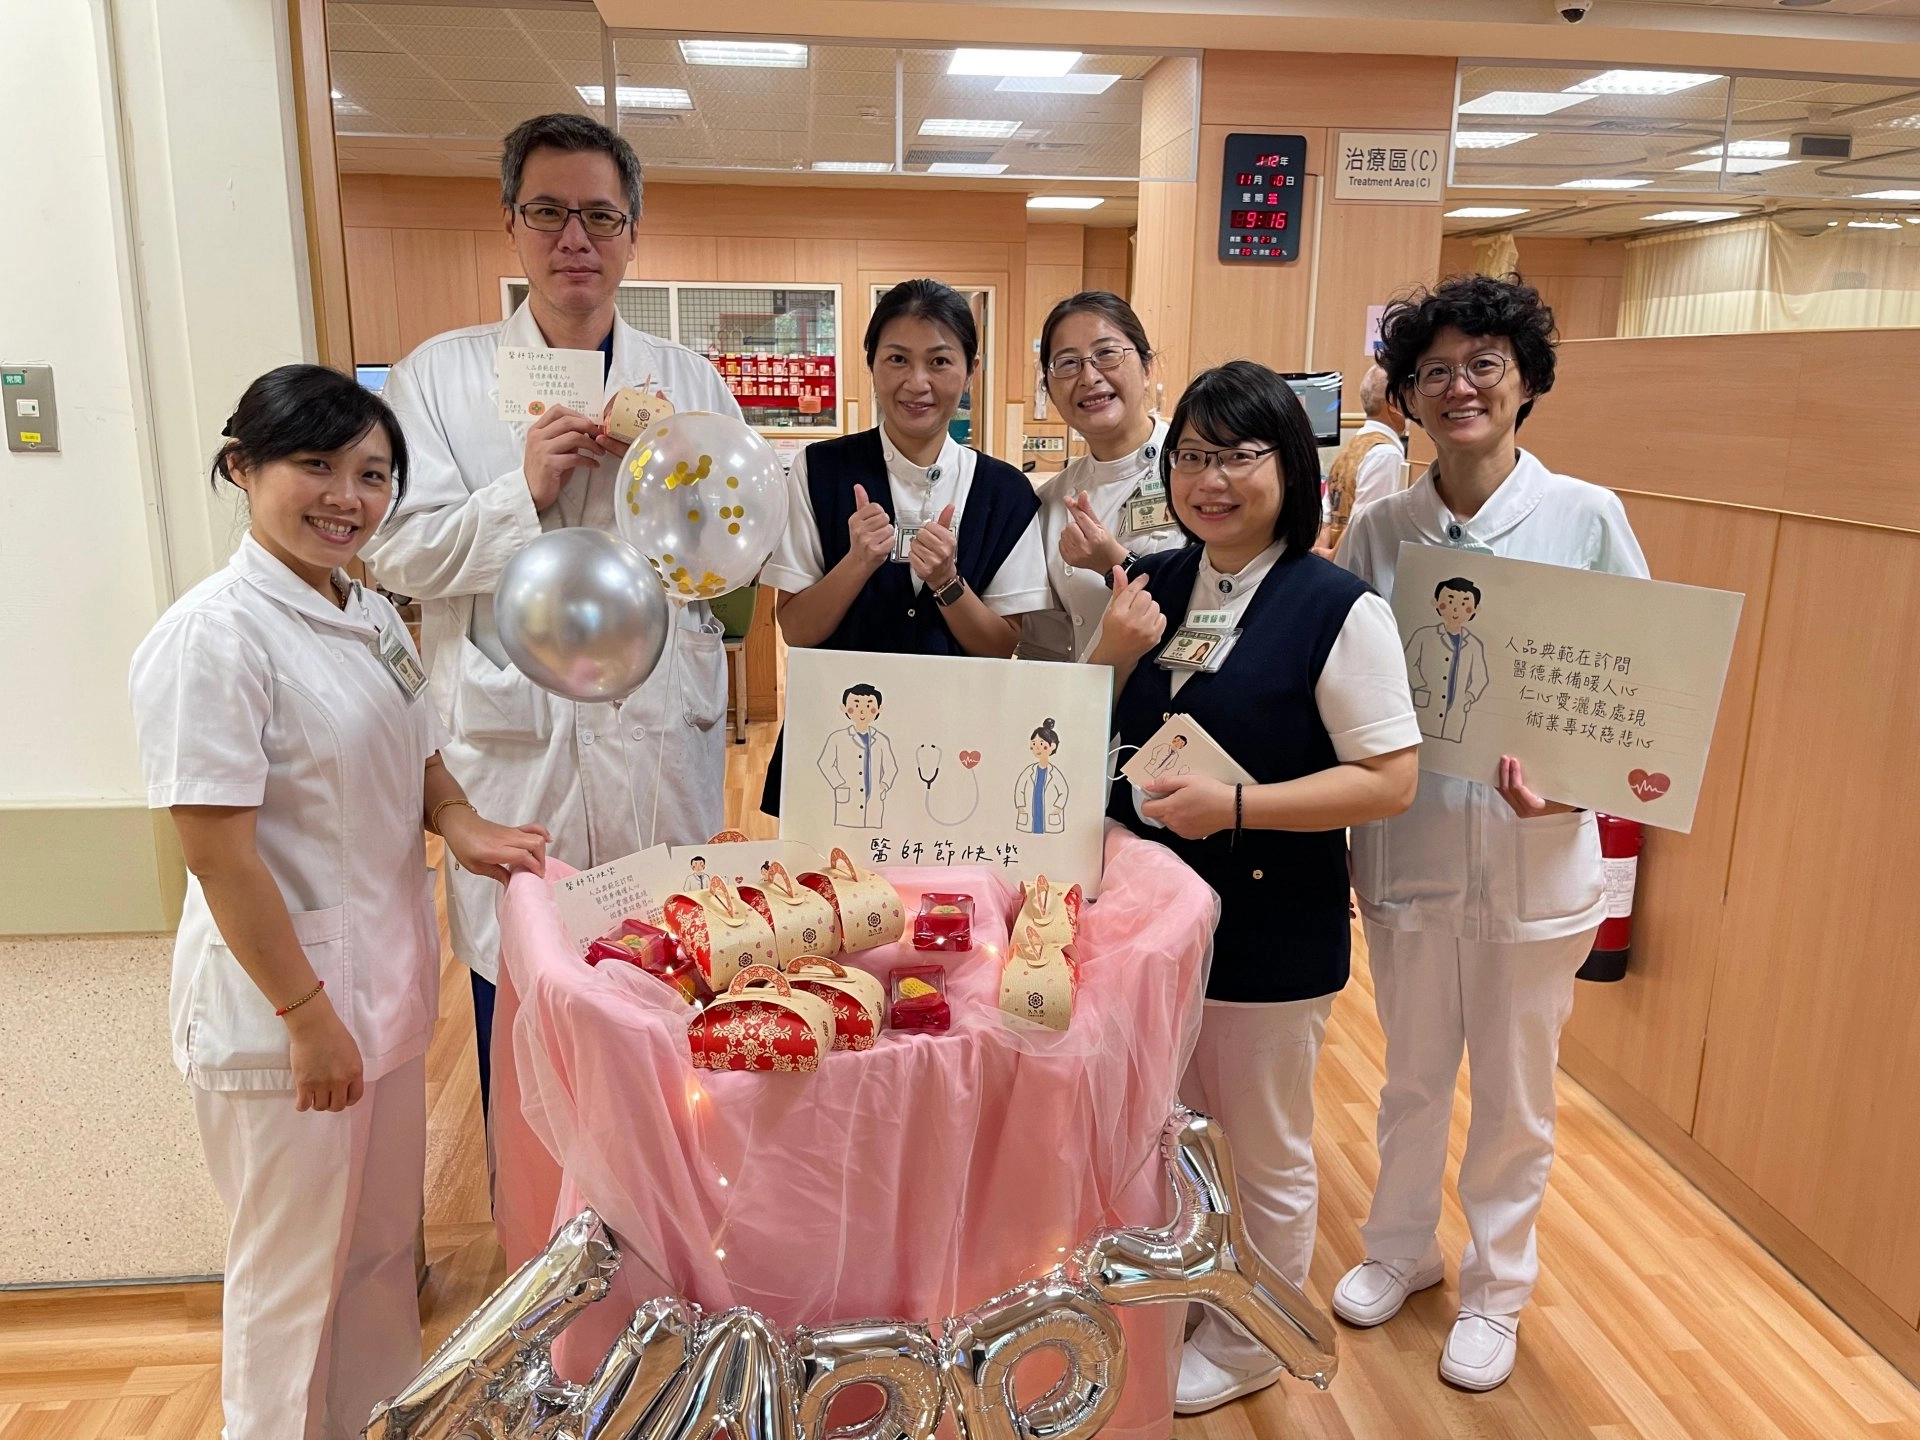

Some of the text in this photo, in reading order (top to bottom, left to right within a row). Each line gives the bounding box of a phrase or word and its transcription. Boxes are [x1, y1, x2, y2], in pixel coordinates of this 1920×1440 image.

[1345, 147, 1438, 172] 治療區(C)
[1240, 174, 1263, 185] 11月
[1349, 176, 1392, 187] Treatment
[1246, 212, 1286, 229] 9:16
[1505, 636, 1631, 675] 人品典範在診間
[1512, 659, 1638, 697] 醫德兼備暖人心
[1519, 685, 1646, 727] 仁心愛灑處處現
[1525, 710, 1654, 749] 術業專攻慈悲心
[870, 838, 1018, 867] 醫師節快樂
